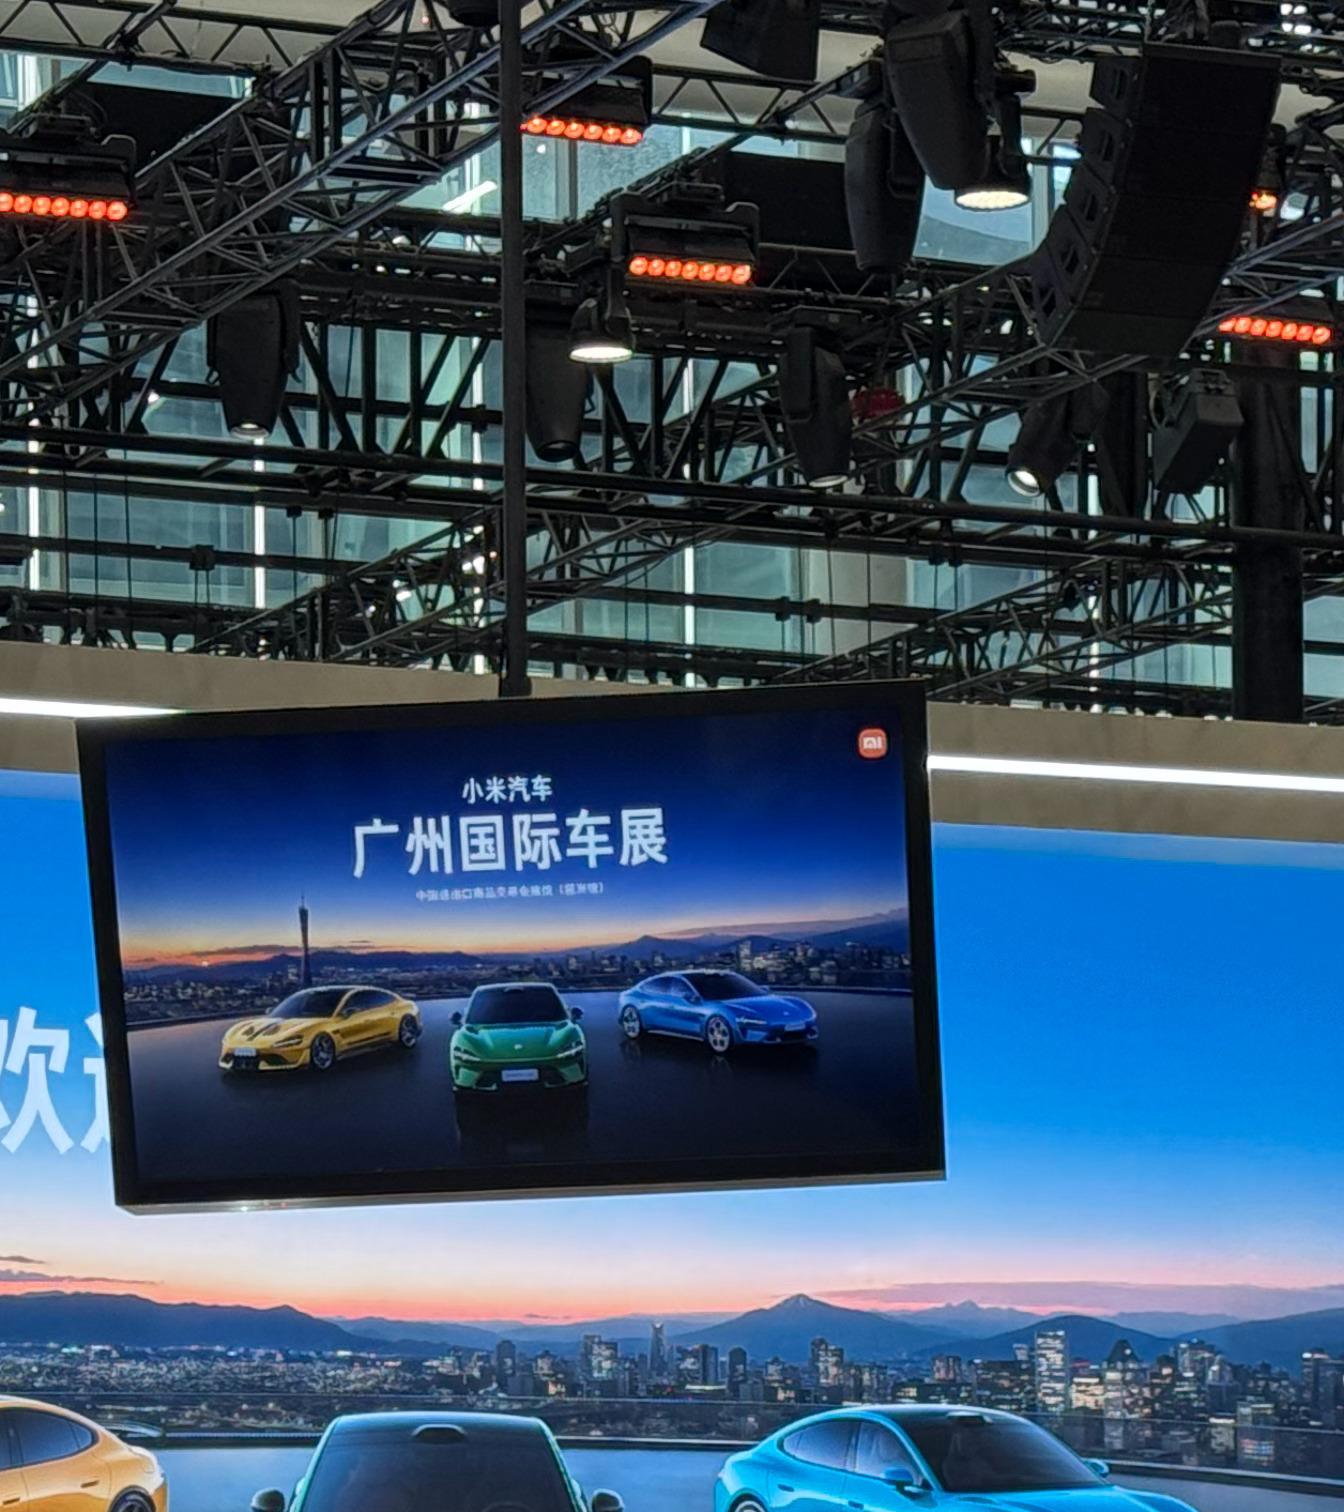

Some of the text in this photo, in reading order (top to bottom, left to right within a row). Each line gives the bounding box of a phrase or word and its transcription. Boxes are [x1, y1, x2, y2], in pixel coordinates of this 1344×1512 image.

[462, 774, 553, 804] 小米汽车
[353, 808, 668, 879] 广州国际车展
